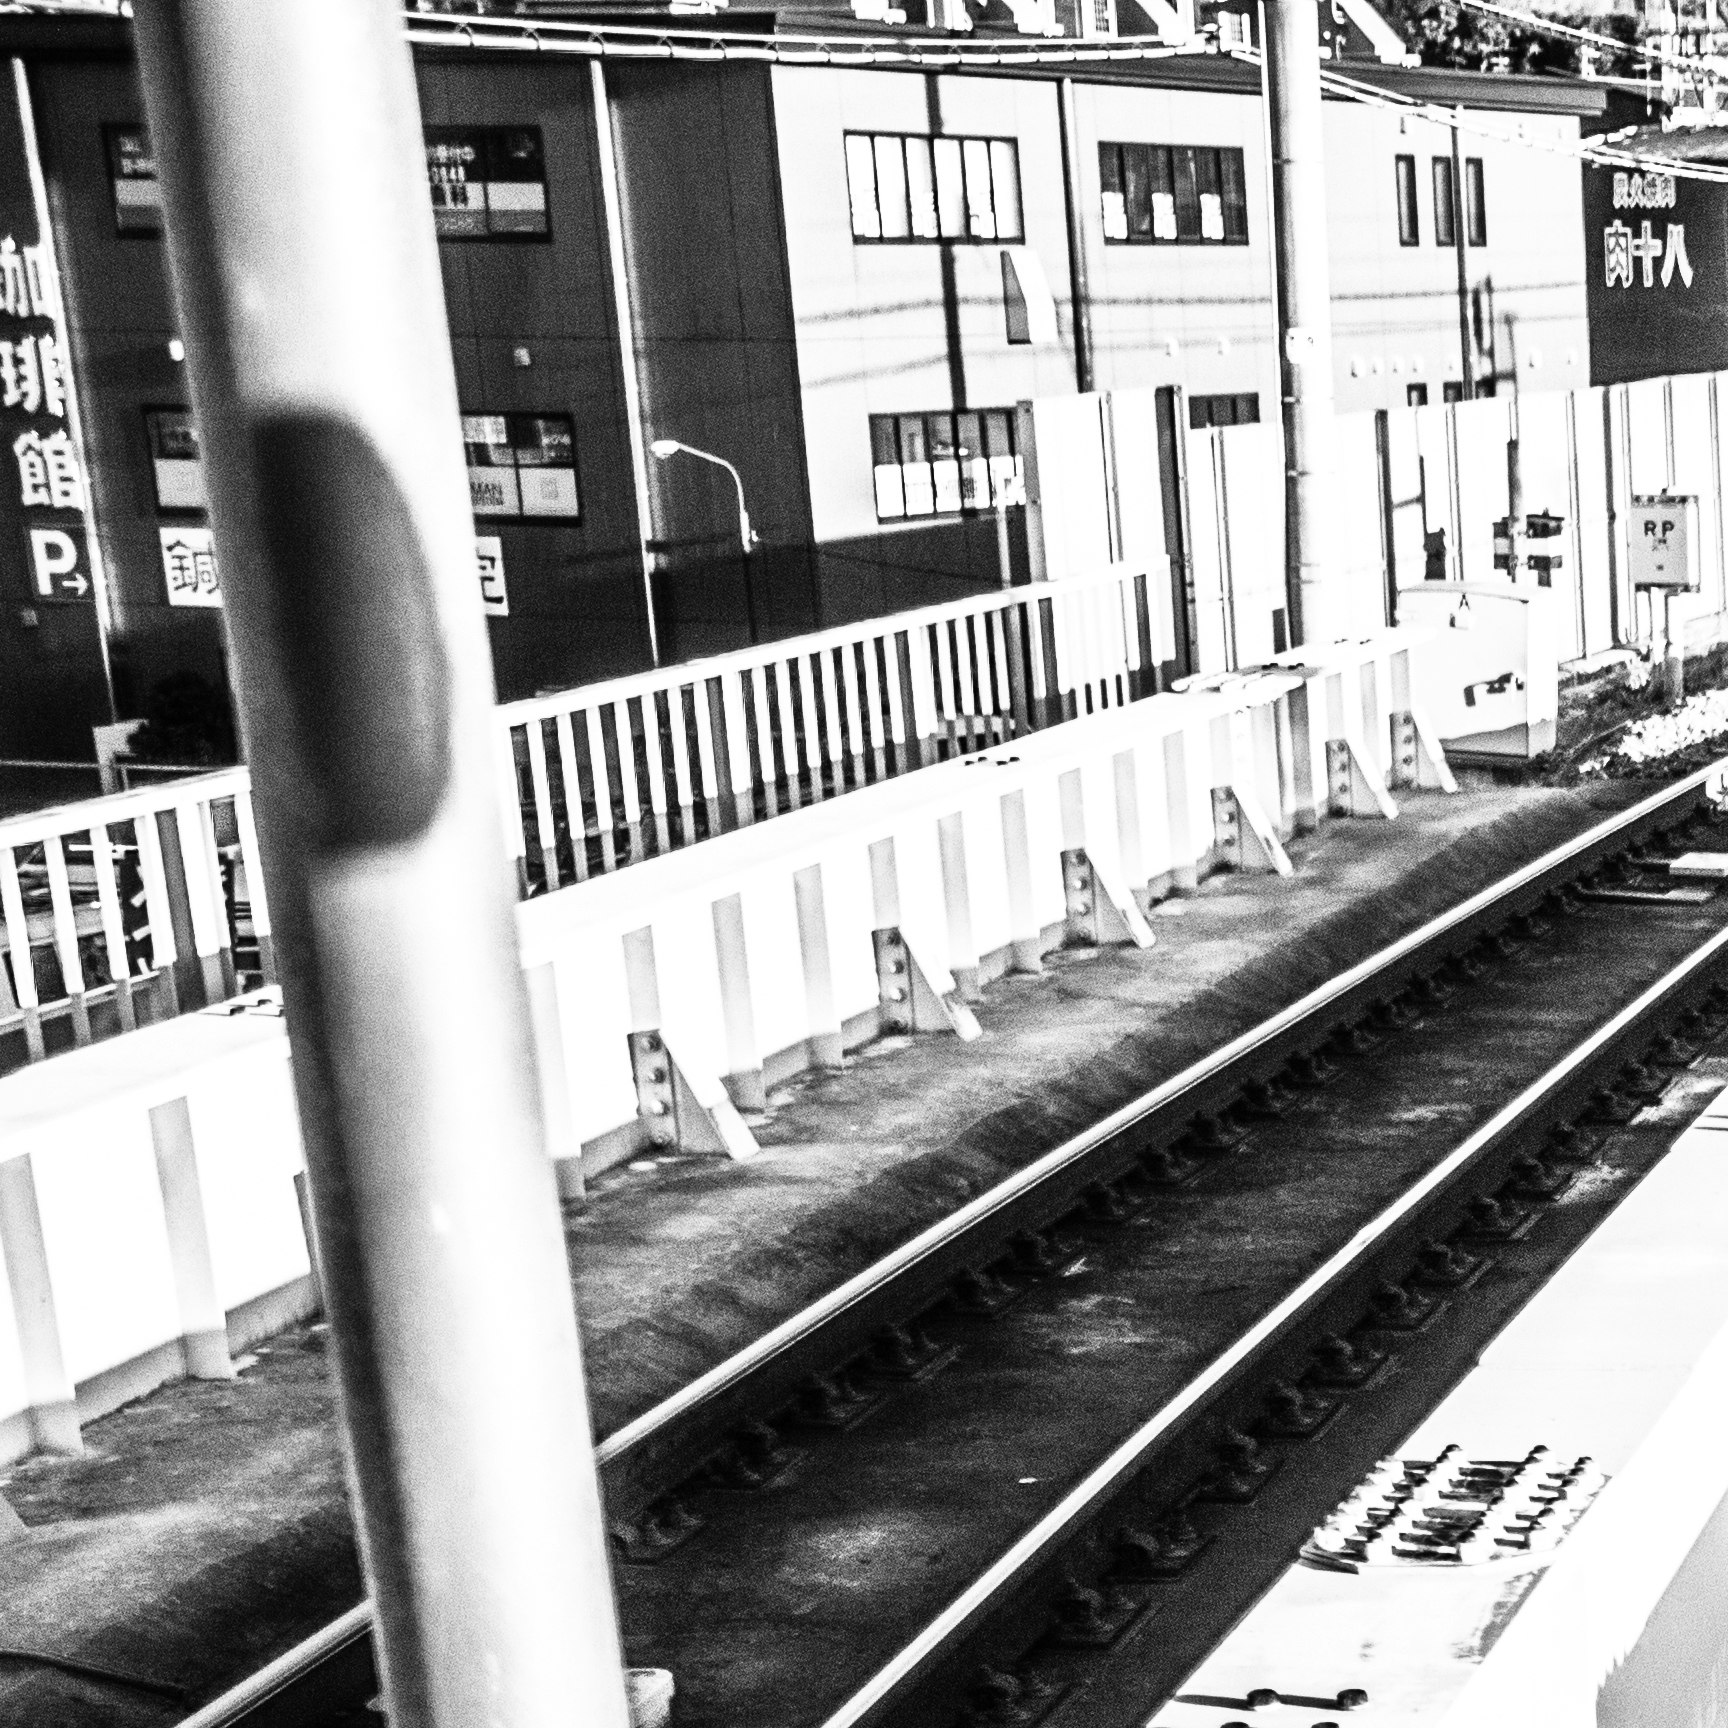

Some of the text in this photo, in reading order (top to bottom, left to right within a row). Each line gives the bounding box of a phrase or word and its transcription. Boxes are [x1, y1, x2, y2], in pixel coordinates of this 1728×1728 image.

[1604, 219, 1694, 289] 肉十八
[30, 529, 77, 596] P
